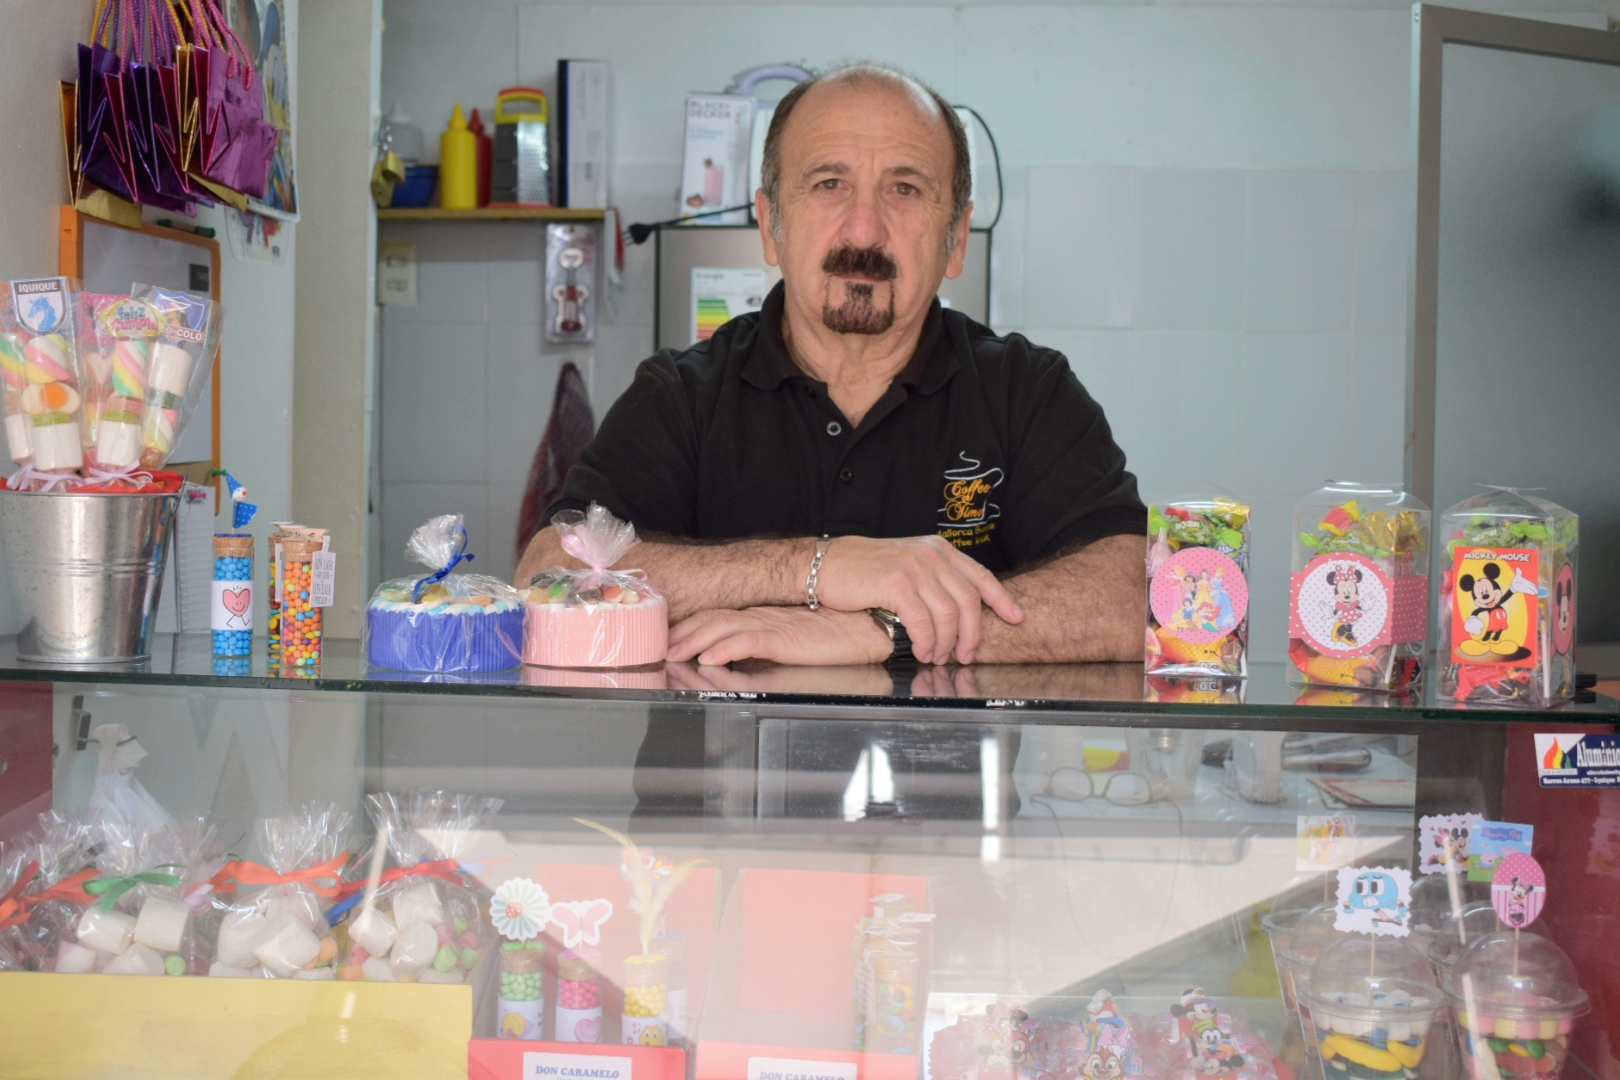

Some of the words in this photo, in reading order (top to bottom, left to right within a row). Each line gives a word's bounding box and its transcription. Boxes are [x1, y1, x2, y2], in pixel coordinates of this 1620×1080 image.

[18, 282, 58, 293] IQUIQUE
[943, 479, 992, 501] Coffee
[944, 500, 985, 521] Time
[1463, 552, 1498, 560] MICKEY
[1500, 552, 1530, 562] MOUSE
[535, 1065, 558, 1075] DON
[560, 1067, 620, 1079] CARAMELO
[759, 1071, 783, 1080] DON
